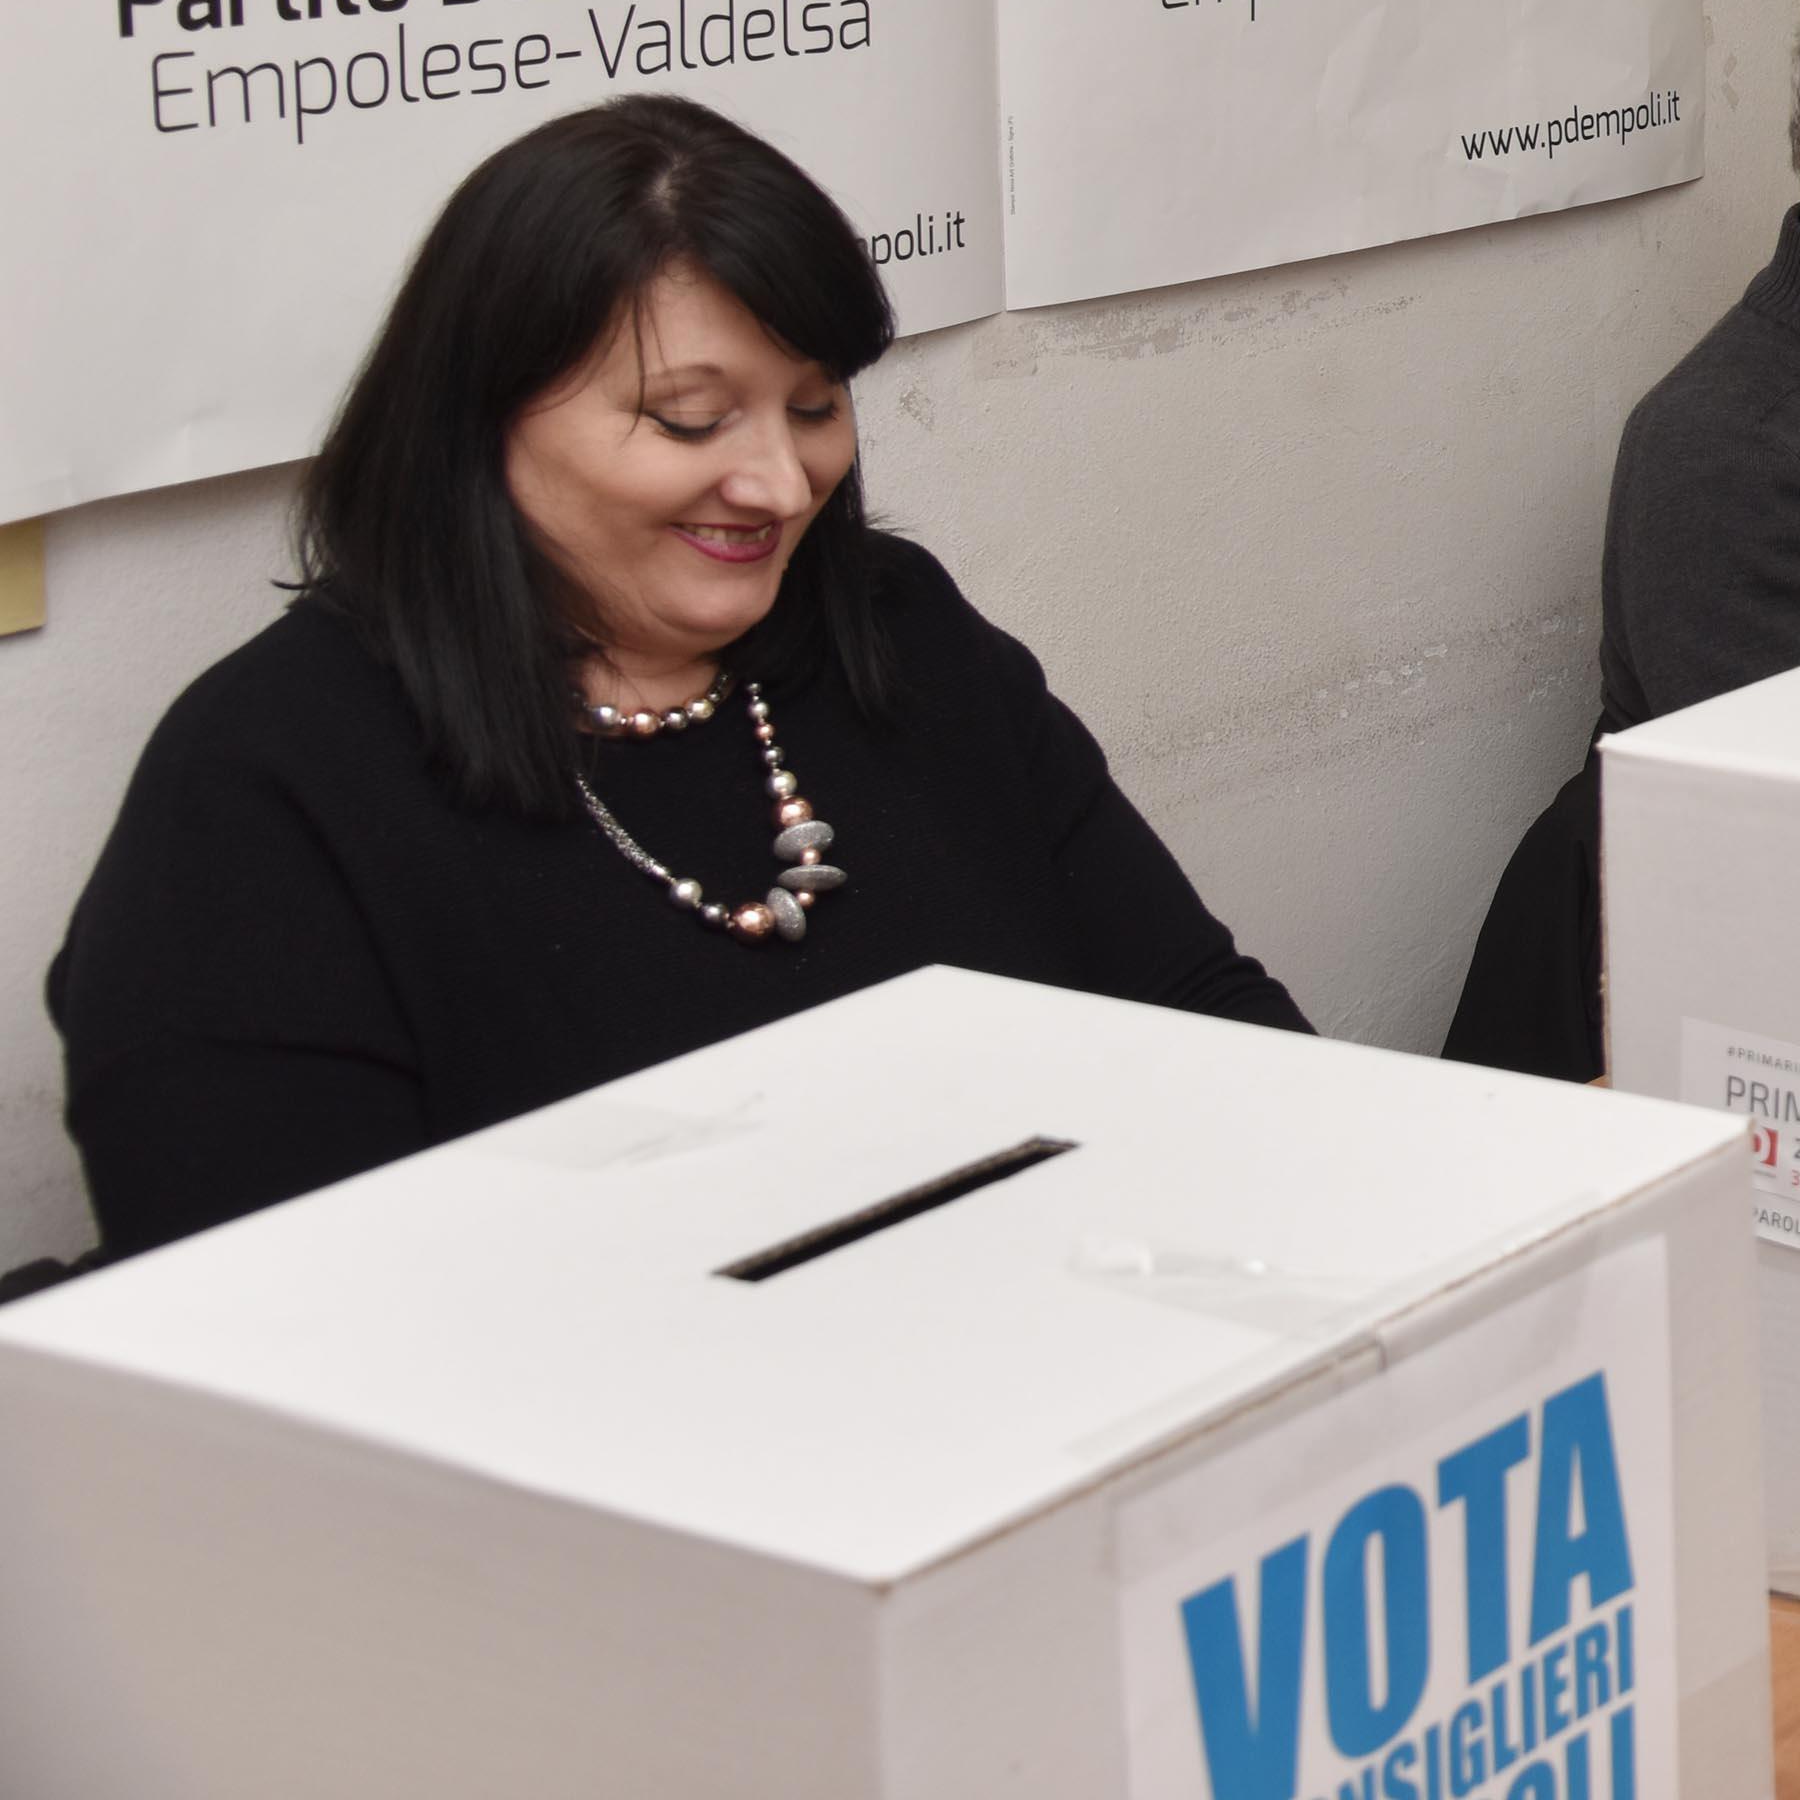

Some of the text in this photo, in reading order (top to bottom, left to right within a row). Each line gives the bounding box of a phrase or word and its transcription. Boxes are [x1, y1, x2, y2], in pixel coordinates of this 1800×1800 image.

[1461, 91, 1681, 161] www.pdempoli.it
[1791, 1169, 1800, 1187] 3
[1179, 1368, 1636, 1800] VOTA
